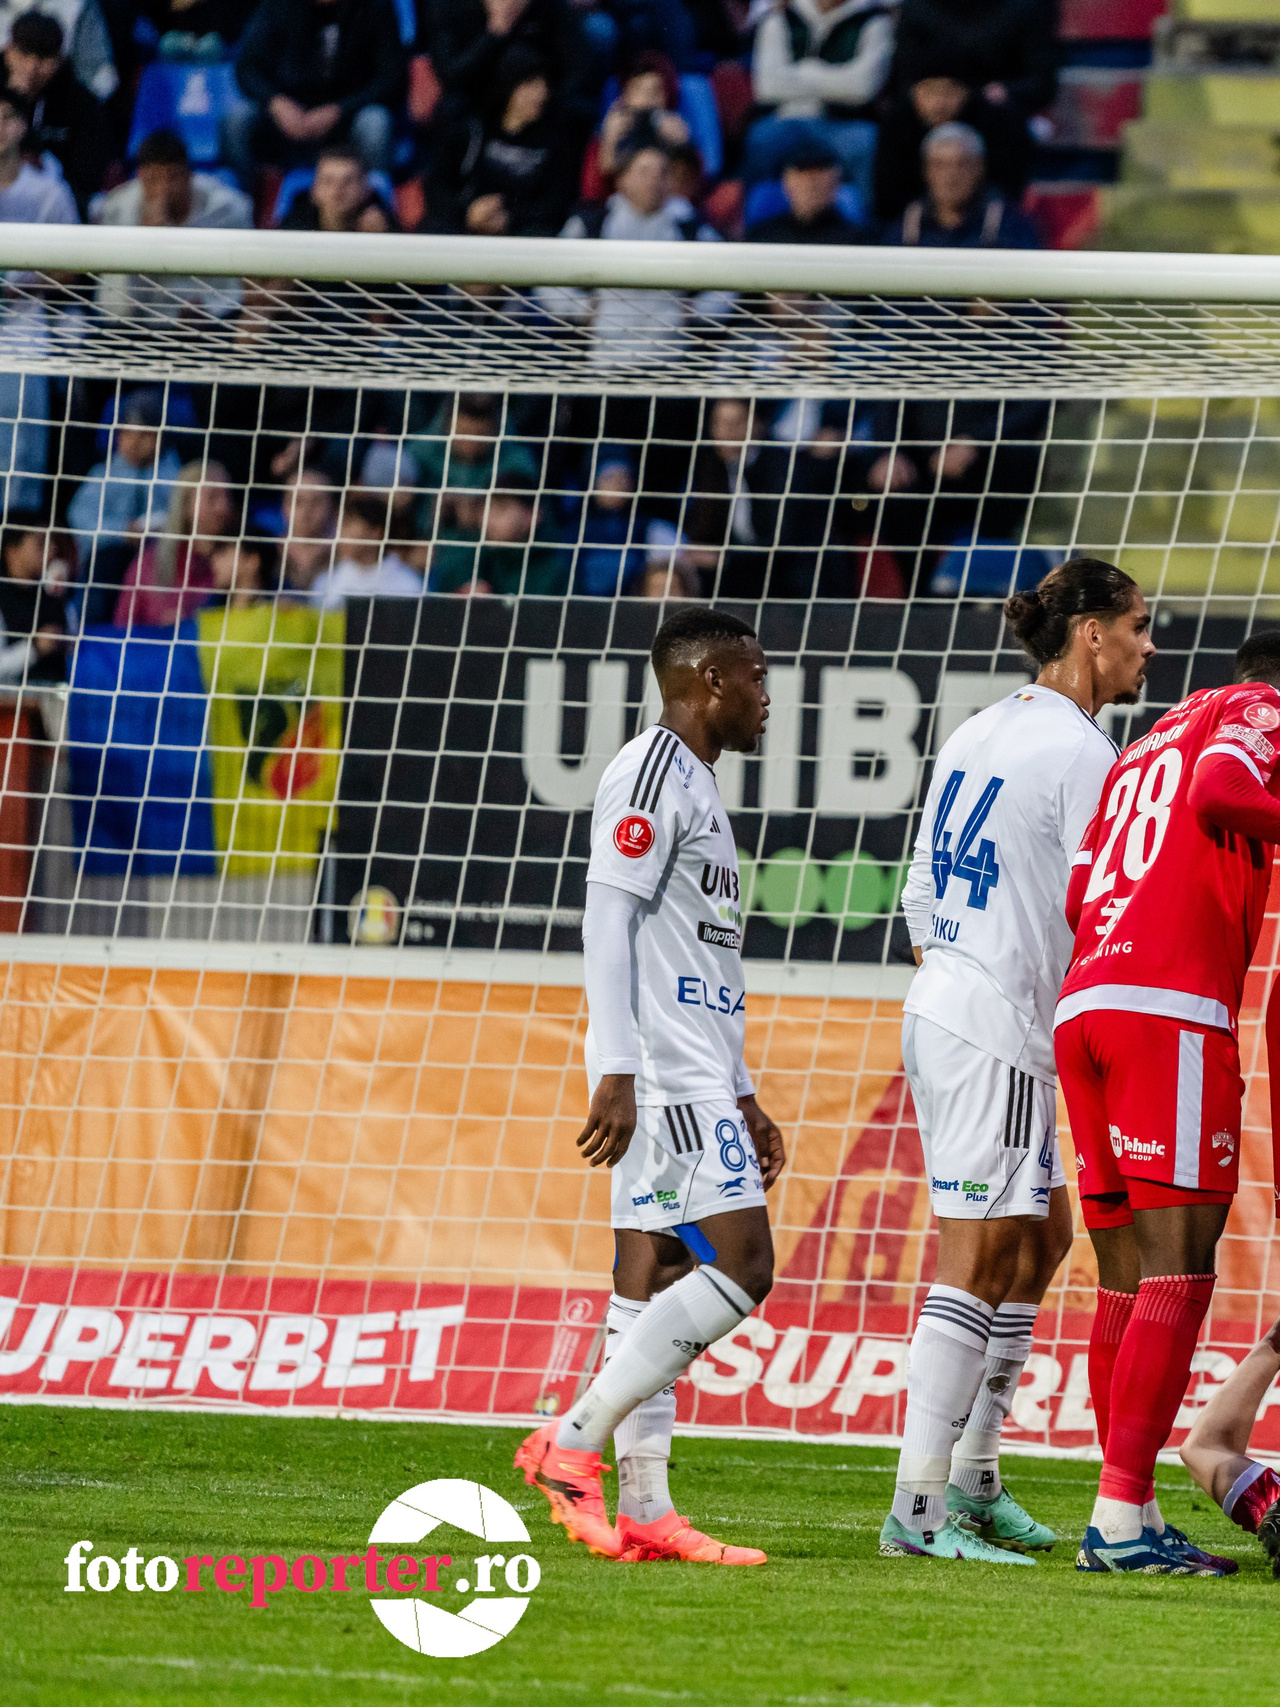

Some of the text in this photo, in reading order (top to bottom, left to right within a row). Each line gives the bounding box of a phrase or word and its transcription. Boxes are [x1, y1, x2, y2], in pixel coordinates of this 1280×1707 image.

[1083, 748, 1183, 904] 28
[932, 770, 1005, 911] 44
[1122, 1135, 1166, 1156] Tehnic
[1129, 1153, 1153, 1162] GROUP
[962, 1180, 989, 1193] Eco
[656, 1189, 678, 1203] Eco
[965, 1192, 989, 1202] Plus
[662, 1201, 681, 1211] Plus
[0, 1296, 466, 1391] UPERBET
